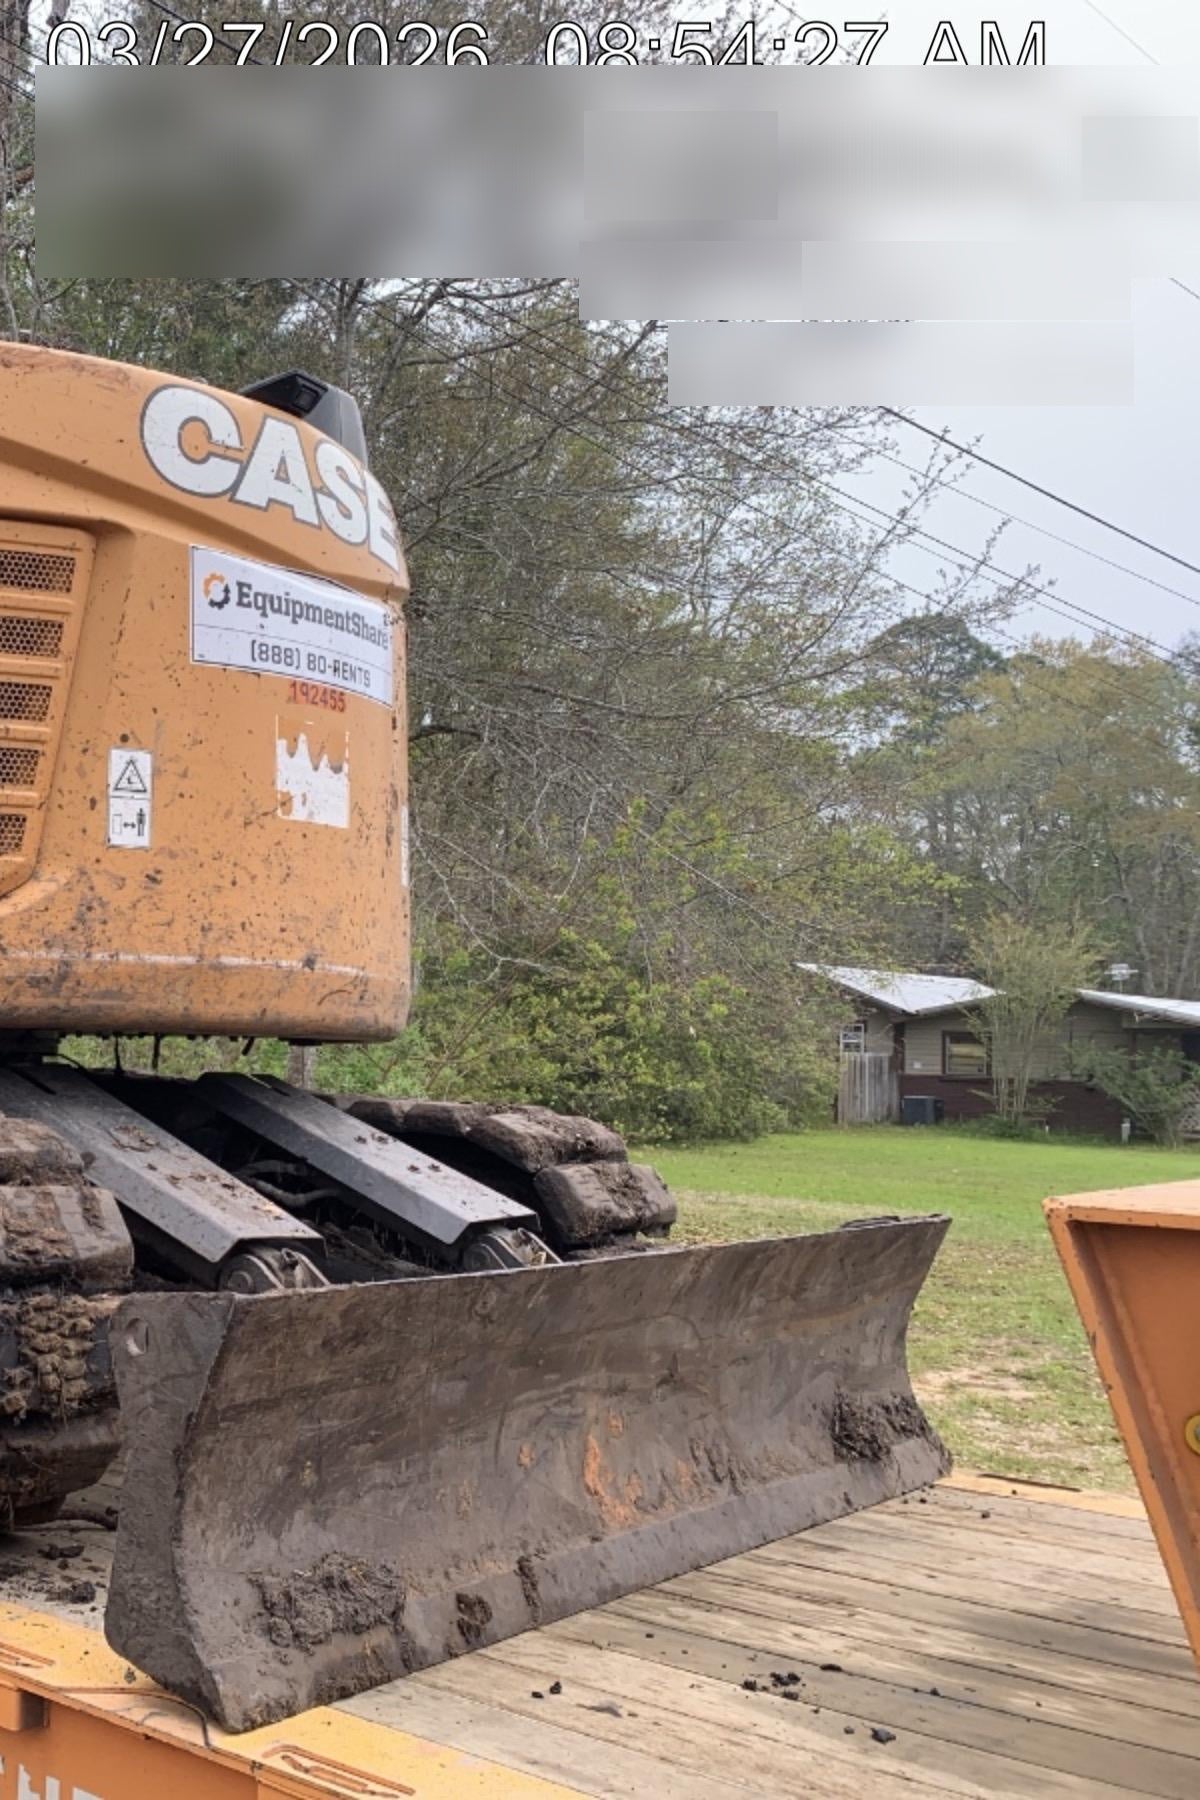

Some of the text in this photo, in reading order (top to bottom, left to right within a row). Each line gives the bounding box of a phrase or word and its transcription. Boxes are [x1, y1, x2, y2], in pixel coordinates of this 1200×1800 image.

[140, 384, 400, 572] CASE
[235, 580, 389, 650] EquipmentShare
[250, 639, 300, 670] (888)
[289, 681, 347, 713] 192455
